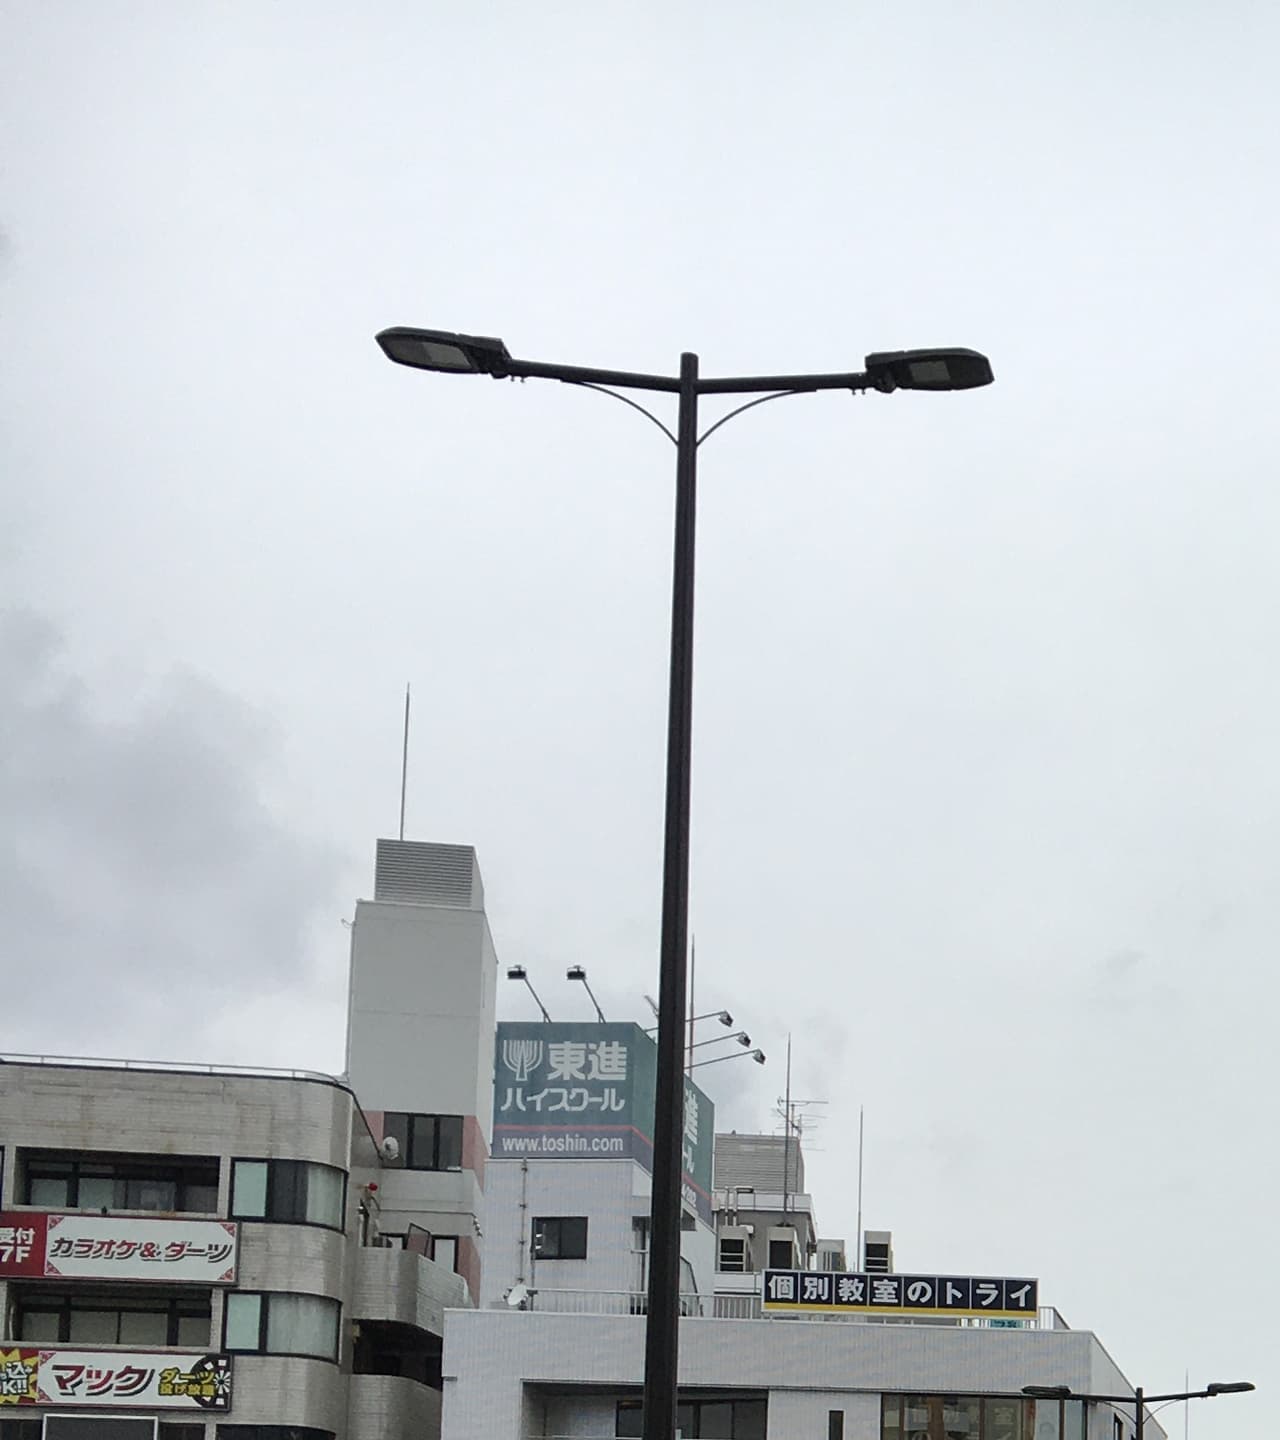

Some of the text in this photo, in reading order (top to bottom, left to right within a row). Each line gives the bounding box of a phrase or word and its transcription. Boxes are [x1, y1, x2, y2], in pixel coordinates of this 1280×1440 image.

[547, 1040, 628, 1081] 東進
[500, 1087, 626, 1112] ハイスクール
[502, 1134, 624, 1152] www.toshin.com
[768, 1275, 1031, 1307] 個別教室のトライ
[52, 1365, 154, 1397] マック
